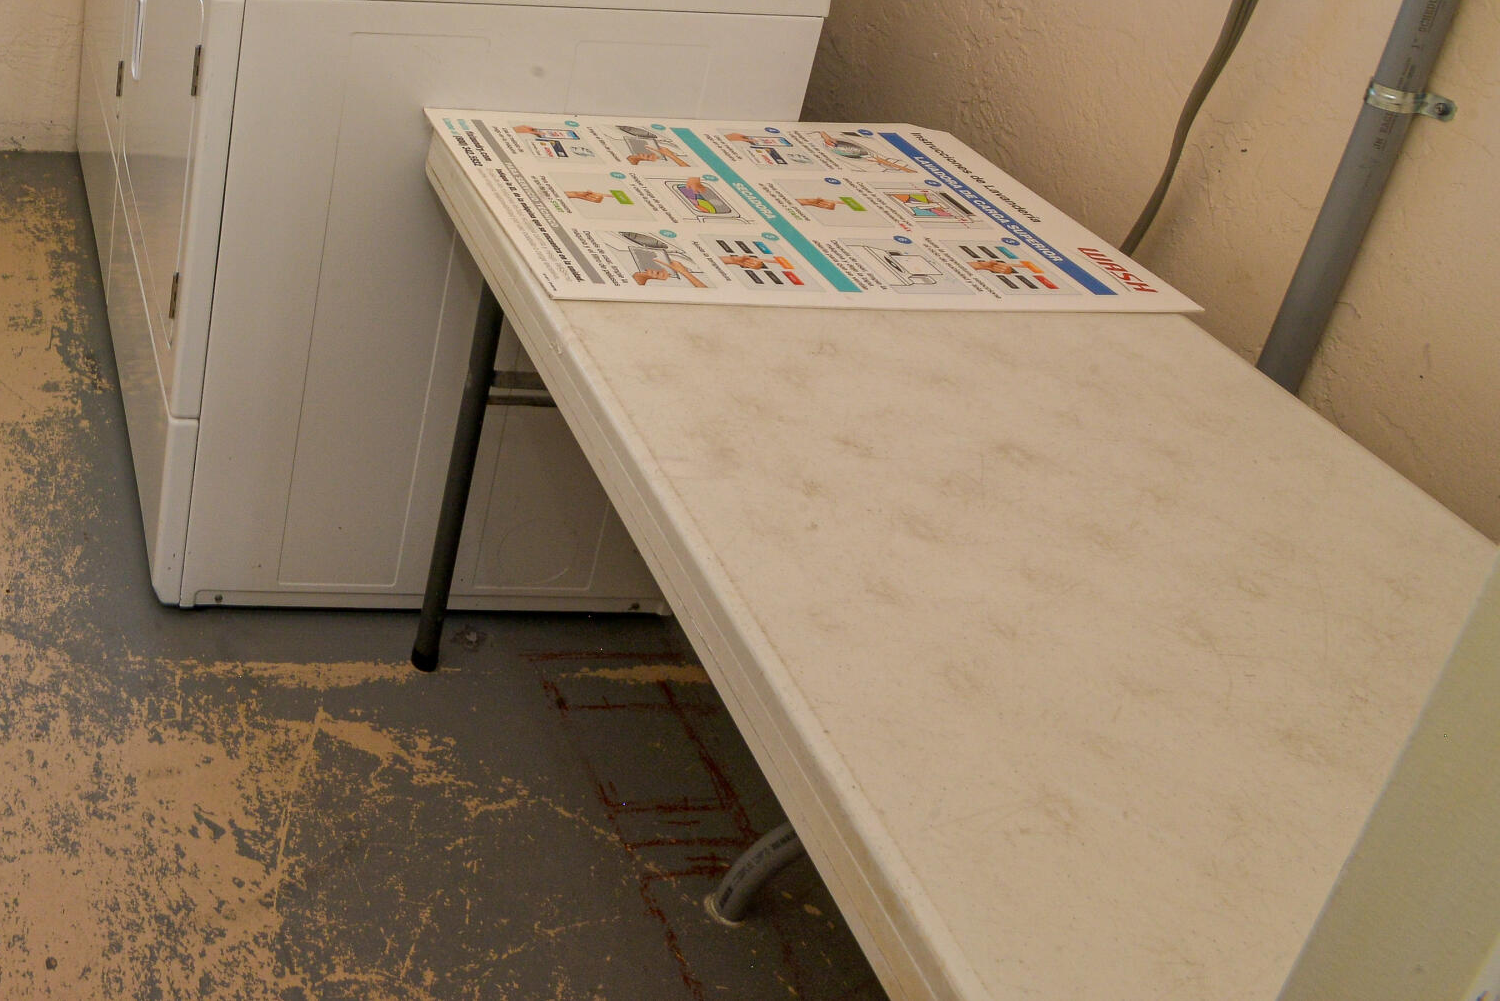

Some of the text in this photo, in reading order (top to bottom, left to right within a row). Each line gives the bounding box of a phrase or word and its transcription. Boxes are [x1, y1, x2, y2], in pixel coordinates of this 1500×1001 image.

[464, 130, 494, 161] fixlaundry.com
[730, 182, 778, 218] SECADORA
[909, 132, 1046, 222] Instrucciones de Lavandería
[494, 168, 510, 181] Indique
[519, 202, 538, 218] máquina
[541, 233, 564, 253] encuentra
[565, 265, 585, 282] unidad.
[912, 156, 1066, 261] LAVADORA DE CARGA SUPERIOR
[570, 228, 590, 245] máquina
[602, 269, 622, 286] pelusas
[581, 230, 602, 247] Después
[608, 265, 626, 278] limpie
[828, 239, 853, 256] Después
[1074, 247, 1159, 292] WASH
